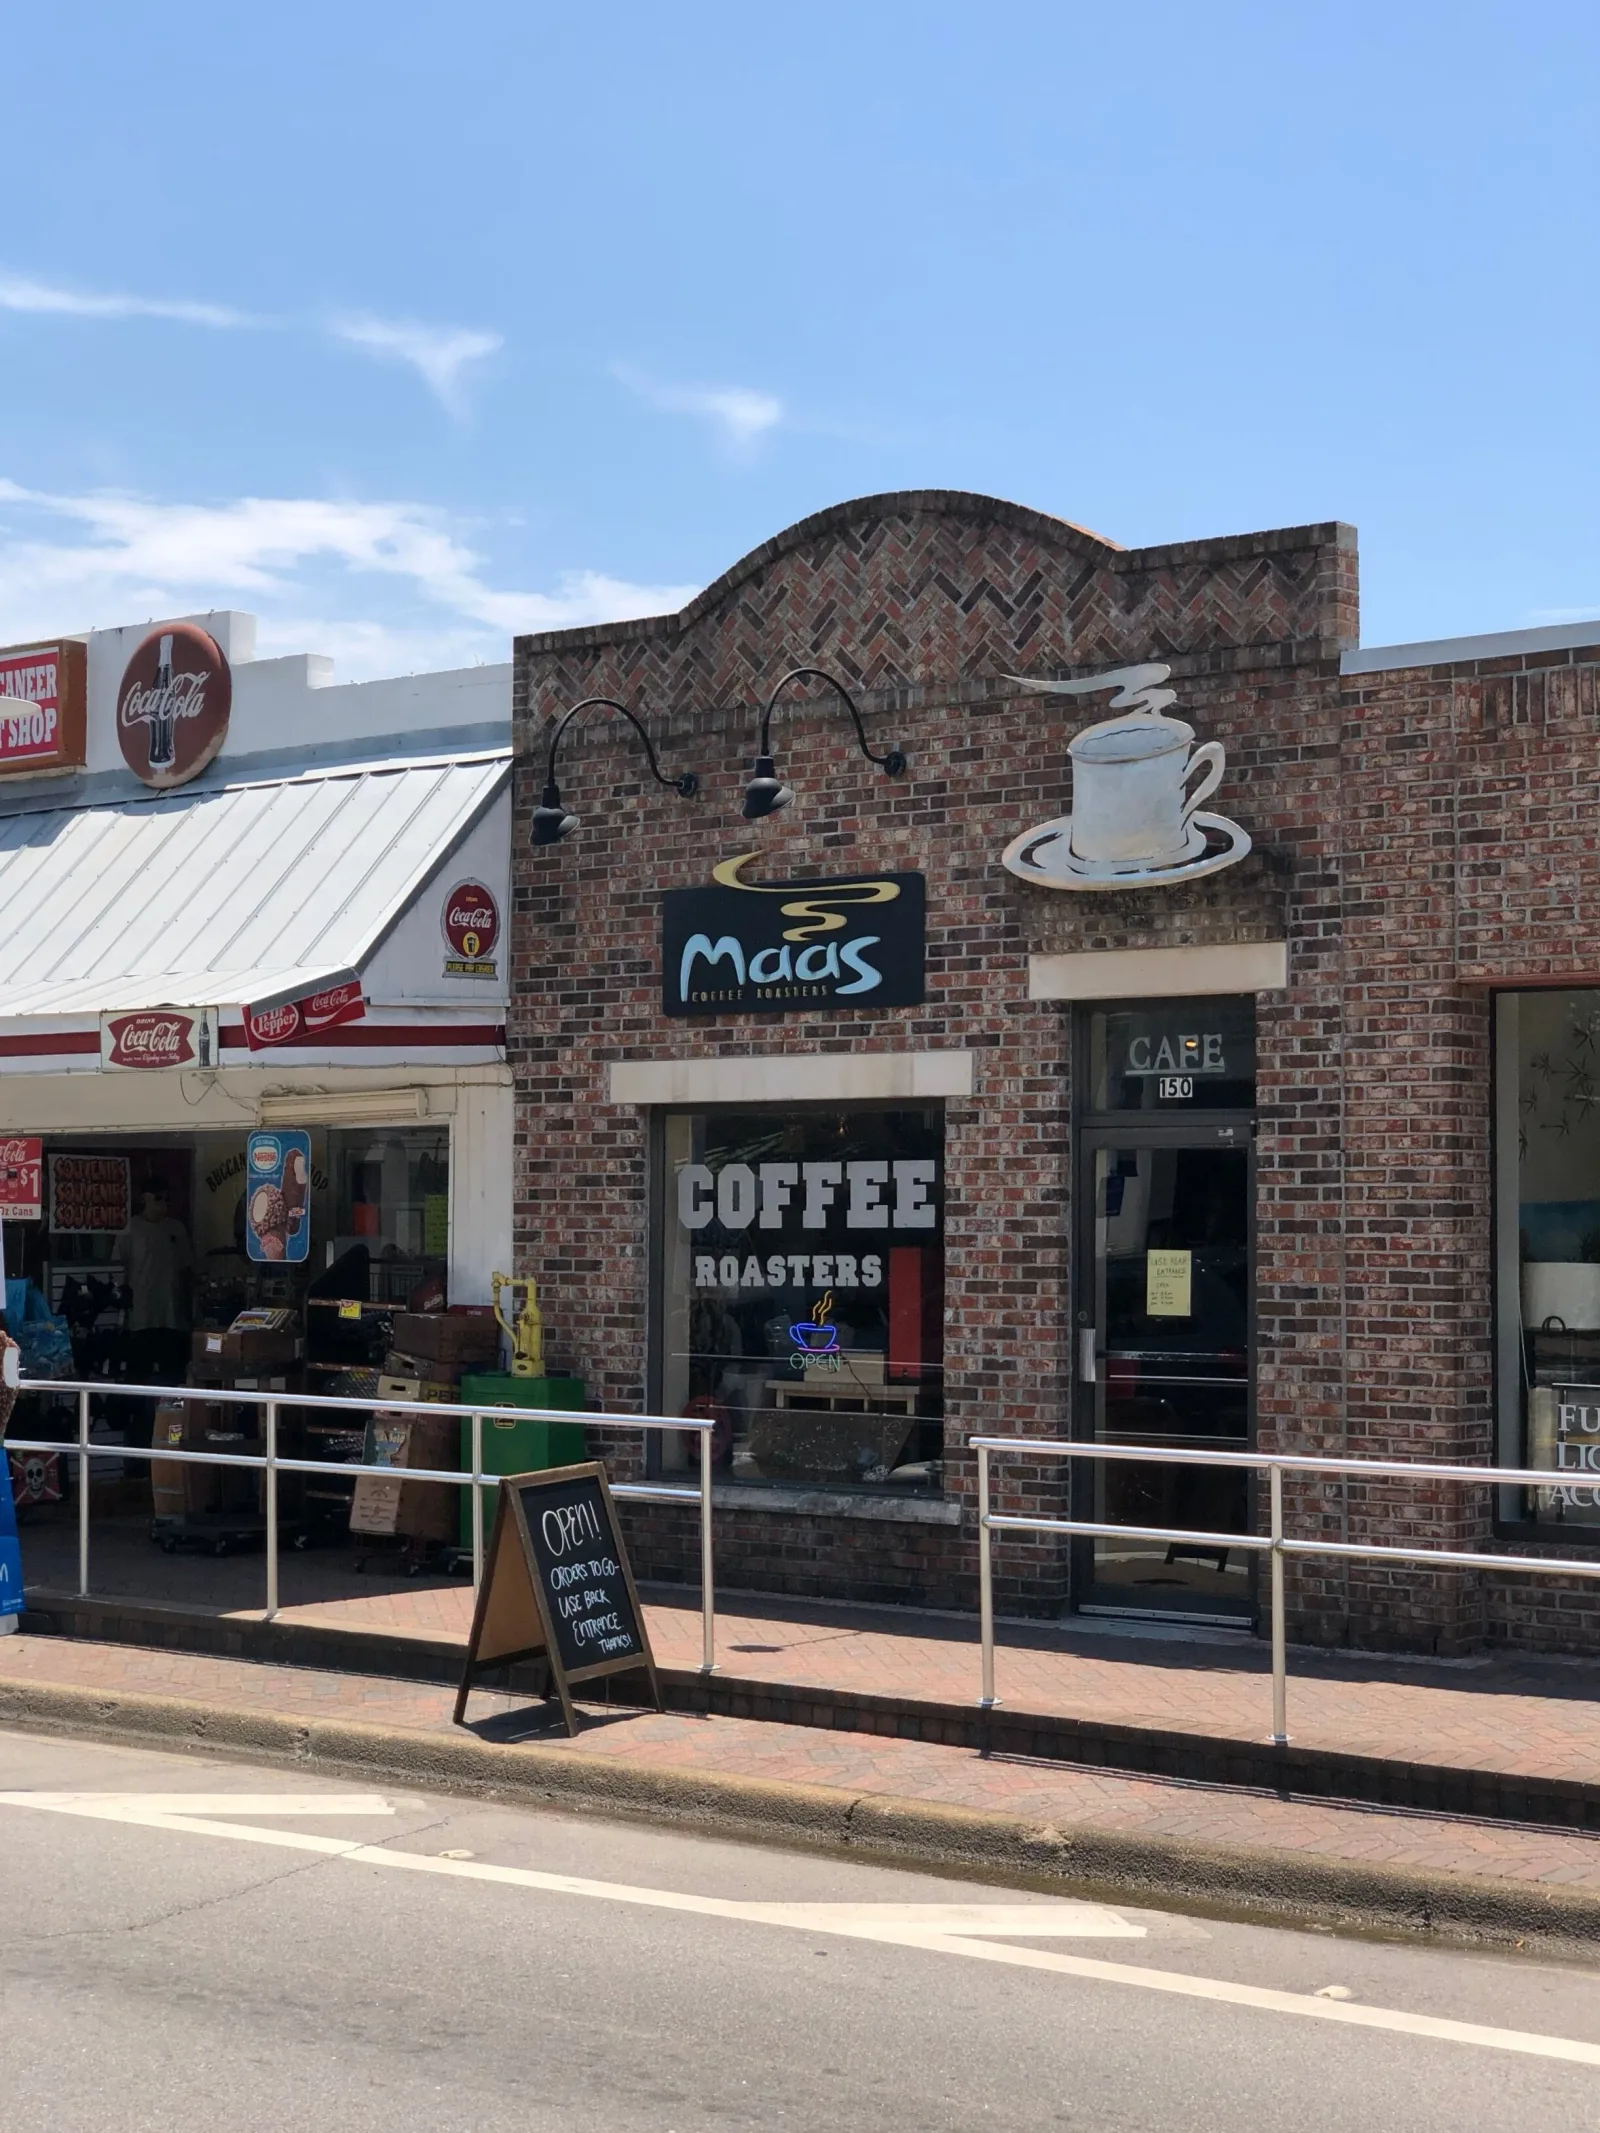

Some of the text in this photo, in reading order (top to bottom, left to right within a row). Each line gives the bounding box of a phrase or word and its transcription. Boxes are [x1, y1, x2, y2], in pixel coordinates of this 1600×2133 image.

[121, 671, 212, 727] Coca-Cola
[9, 708, 57, 748] SHOP
[449, 907, 493, 928] Coca-Cola
[680, 933, 883, 1003] Maas
[312, 987, 349, 1011] Coca-Cola
[691, 985, 828, 1002] COFFEE ROASTERS
[120, 1021, 182, 1053] Coca-Cola
[257, 1012, 296, 1036] Pepper
[1129, 1033, 1226, 1072] CAFE
[1160, 1078, 1192, 1097] 150
[20, 1167, 39, 1198] $1
[678, 1160, 935, 1230] COFFEE
[13, 1206, 34, 1217] Cans
[695, 1254, 882, 1288] ROASTERS
[790, 1352, 840, 1371] OPEN
[542, 1500, 602, 1557] OPEN!
[550, 1563, 588, 1590] ORDERS
[559, 1588, 611, 1618] USE BACK
[598, 1634, 634, 1654] THANKS!
